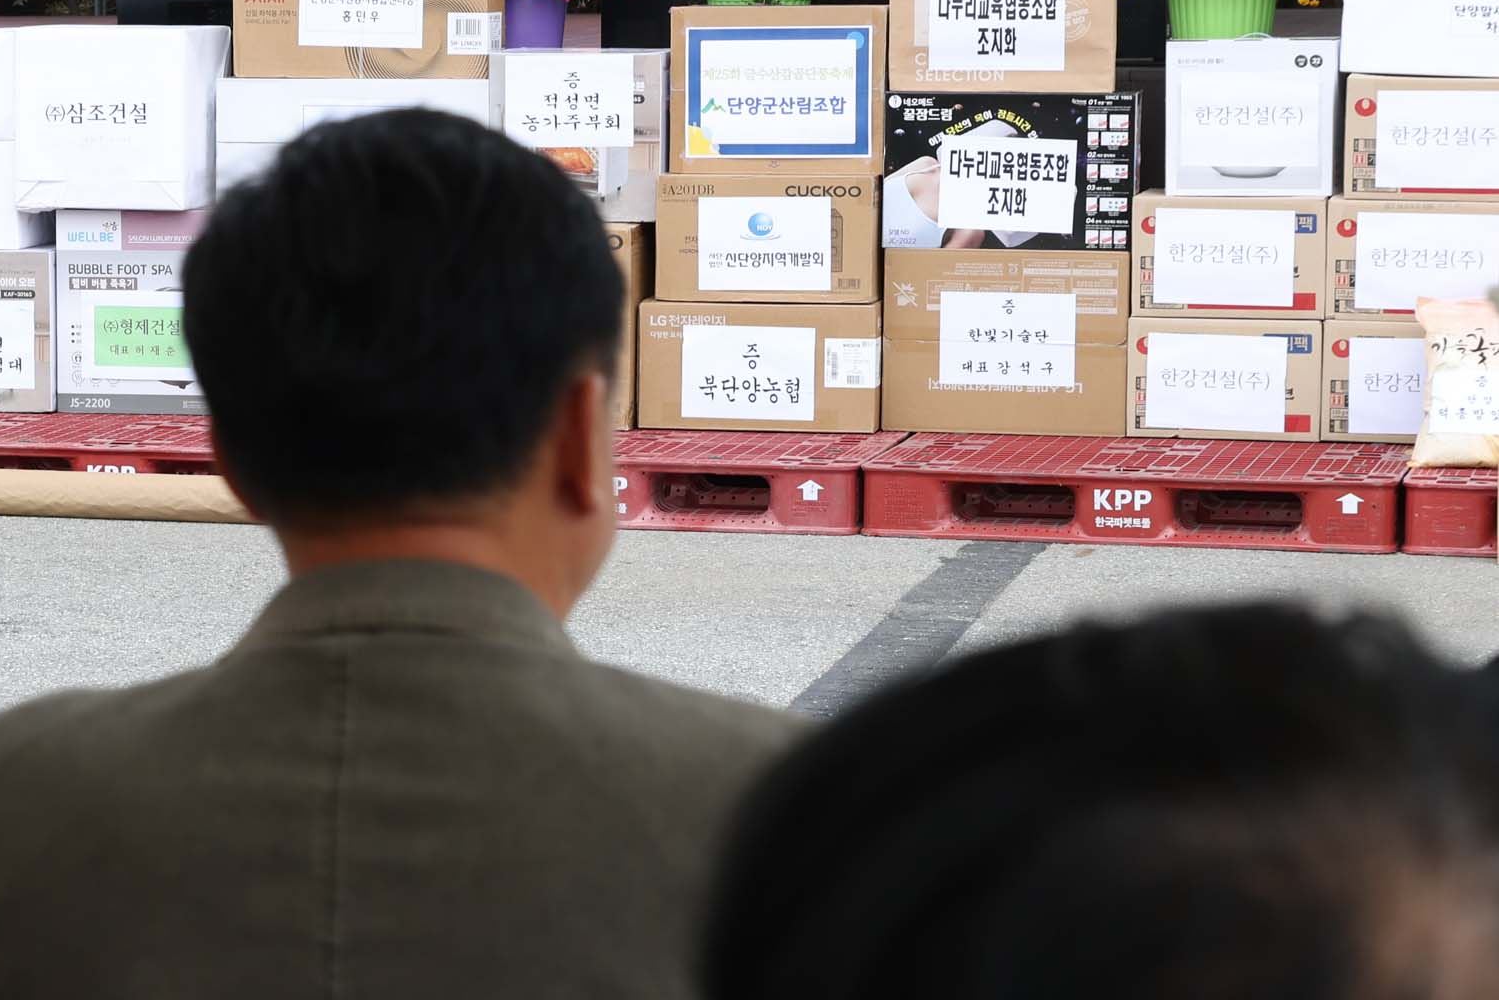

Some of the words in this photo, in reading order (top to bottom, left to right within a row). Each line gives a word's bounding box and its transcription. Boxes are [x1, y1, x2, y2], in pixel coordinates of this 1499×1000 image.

[978, 28, 1016, 55] 조지화
[564, 72, 580, 89] 증
[727, 96, 846, 115] 단양군산림조합
[522, 113, 620, 132] 농가주부회
[1195, 106, 1304, 126] 한강건설(주)
[949, 149, 1069, 183] 다누리교육협동조합
[785, 185, 861, 197] CUCKOO
[987, 187, 1027, 216] 조지화
[725, 252, 824, 268] 신단양지역개발회
[1169, 243, 1279, 264] 한강건설(주)
[1371, 248, 1484, 270] 한강건설(주)
[68, 263, 113, 275] BUBBLE
[117, 264, 146, 275] FOOT
[151, 265, 173, 276] SPA
[1001, 299, 1016, 315] 증
[650, 316, 667, 326] LG
[969, 328, 1050, 343] 한빛기술단
[110, 345, 129, 356] 대표
[743, 344, 760, 369] 증
[961, 361, 989, 374] 대표
[1161, 368, 1271, 390] 한강건설(주)
[700, 376, 801, 404] 북단양농협
[70, 399, 111, 409] JS-2200
[1093, 489, 1152, 511] KPP
